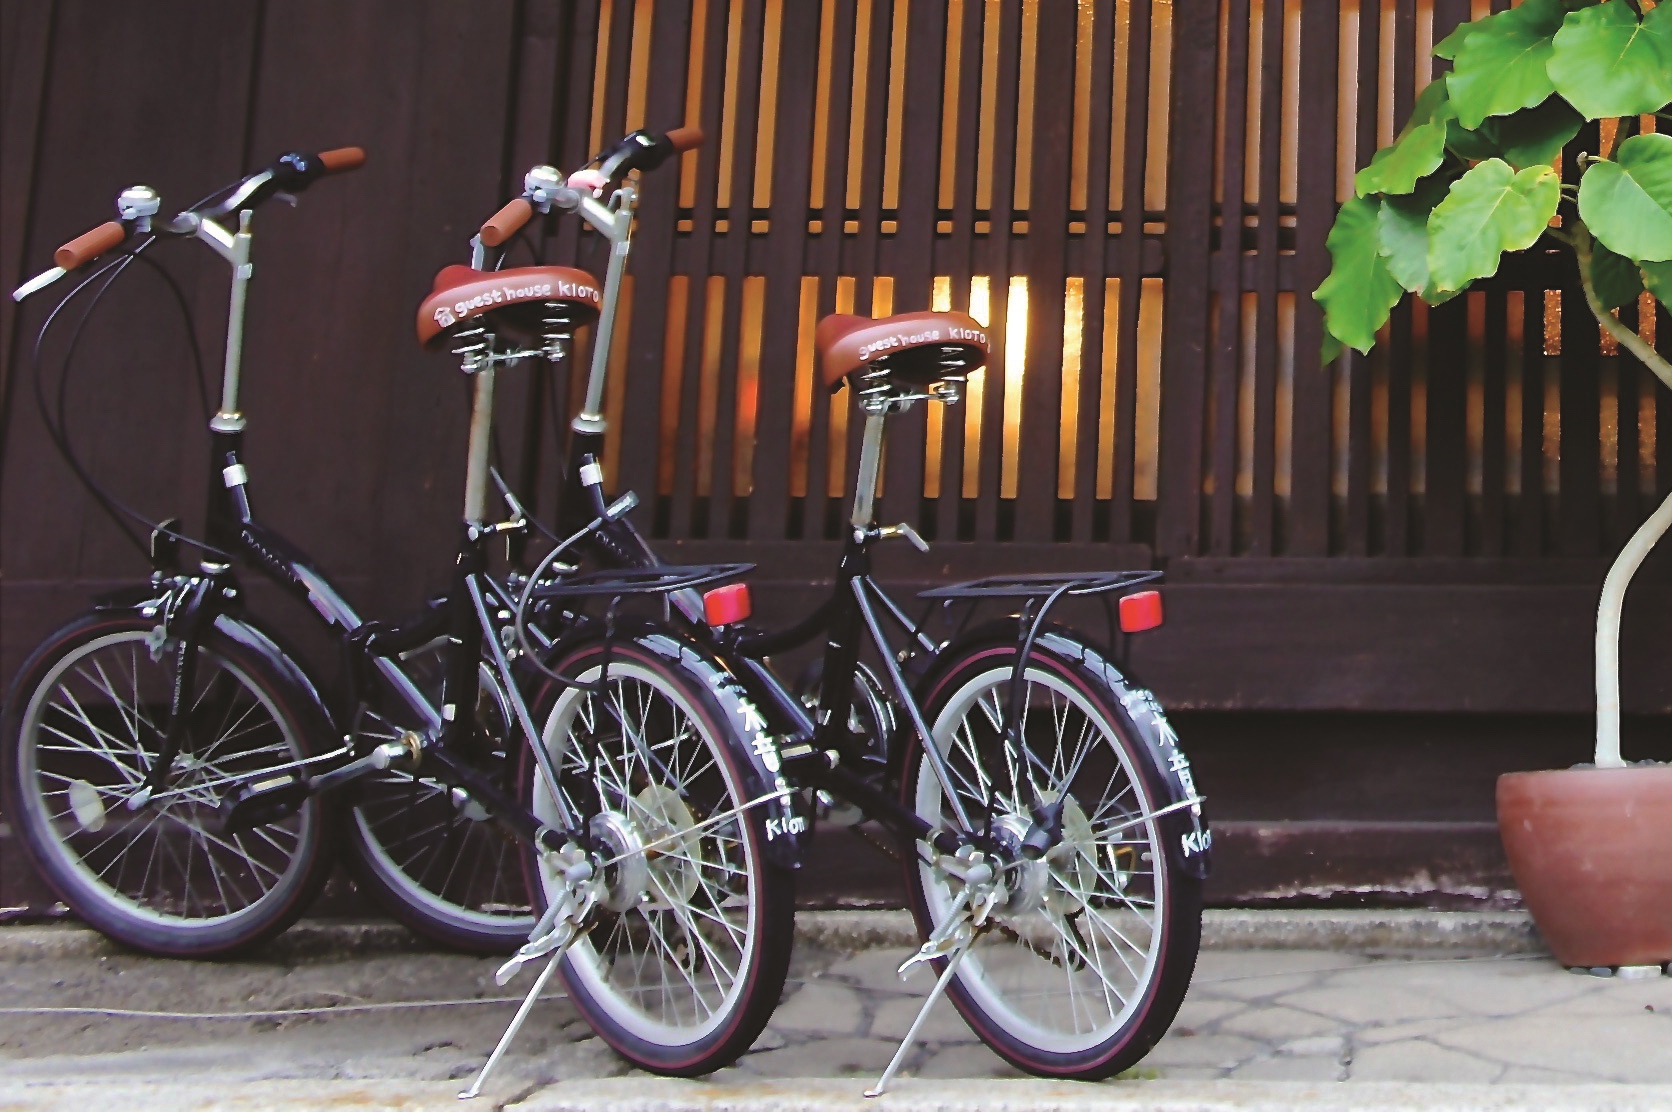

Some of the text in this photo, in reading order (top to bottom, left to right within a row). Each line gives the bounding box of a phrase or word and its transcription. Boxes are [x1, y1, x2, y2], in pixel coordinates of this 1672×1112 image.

[454, 286, 502, 318] guest
[503, 283, 551, 301] house
[858, 327, 986, 361] guest house KIOTO
